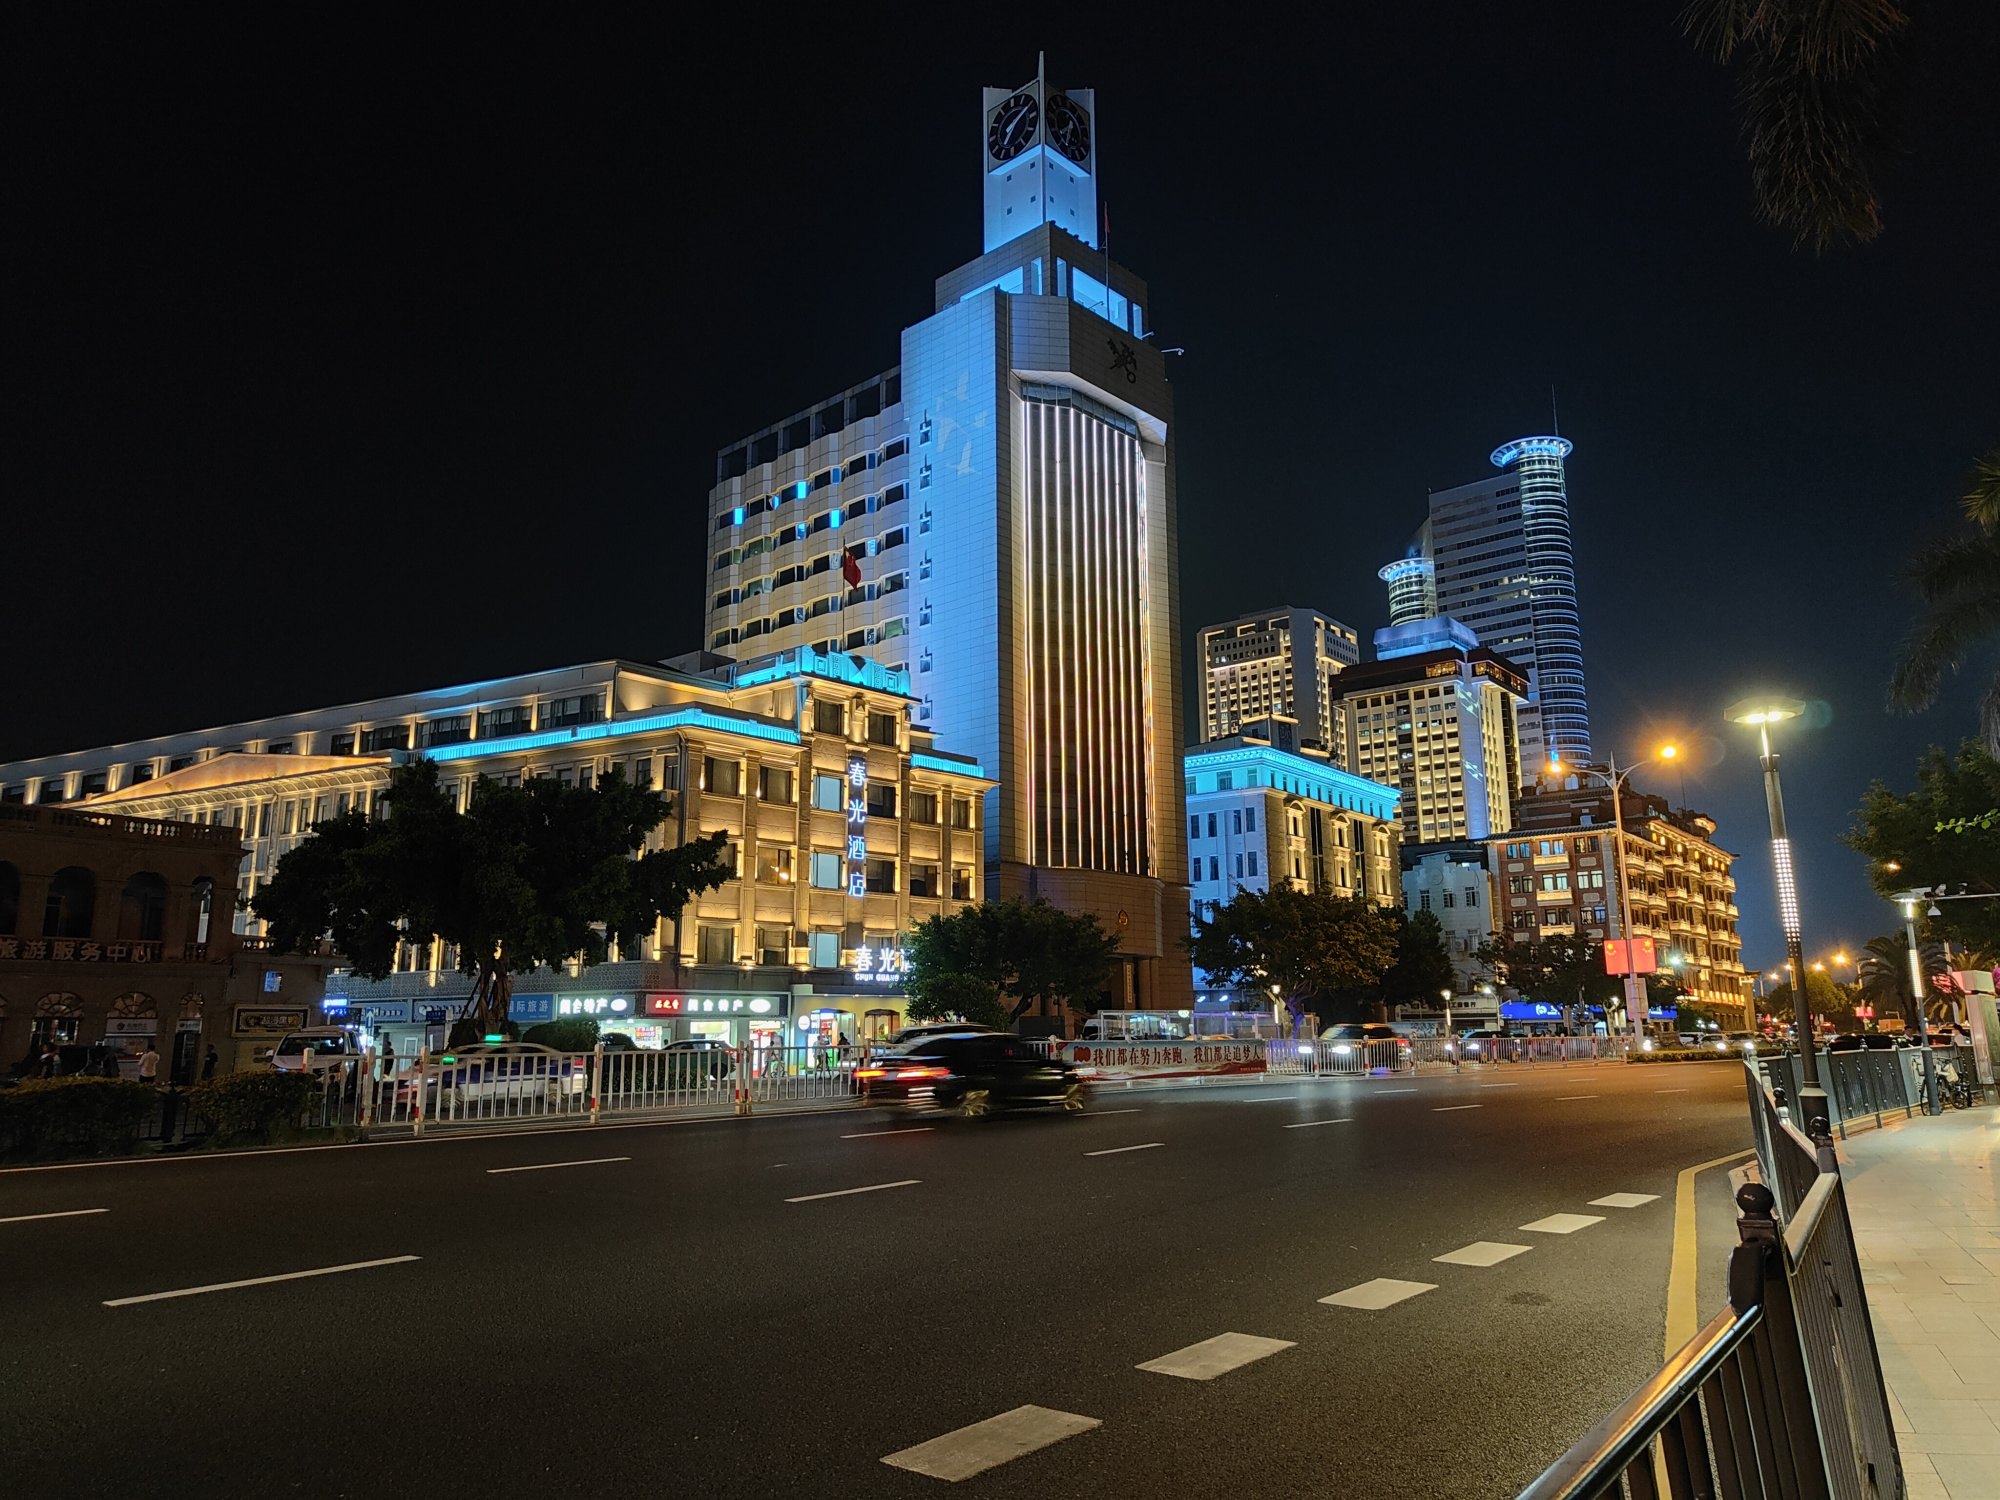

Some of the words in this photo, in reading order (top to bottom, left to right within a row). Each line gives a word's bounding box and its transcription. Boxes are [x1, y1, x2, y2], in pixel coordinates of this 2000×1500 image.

[848, 762, 866, 898] 春光酒店
[854, 972, 874, 981] CHUN
